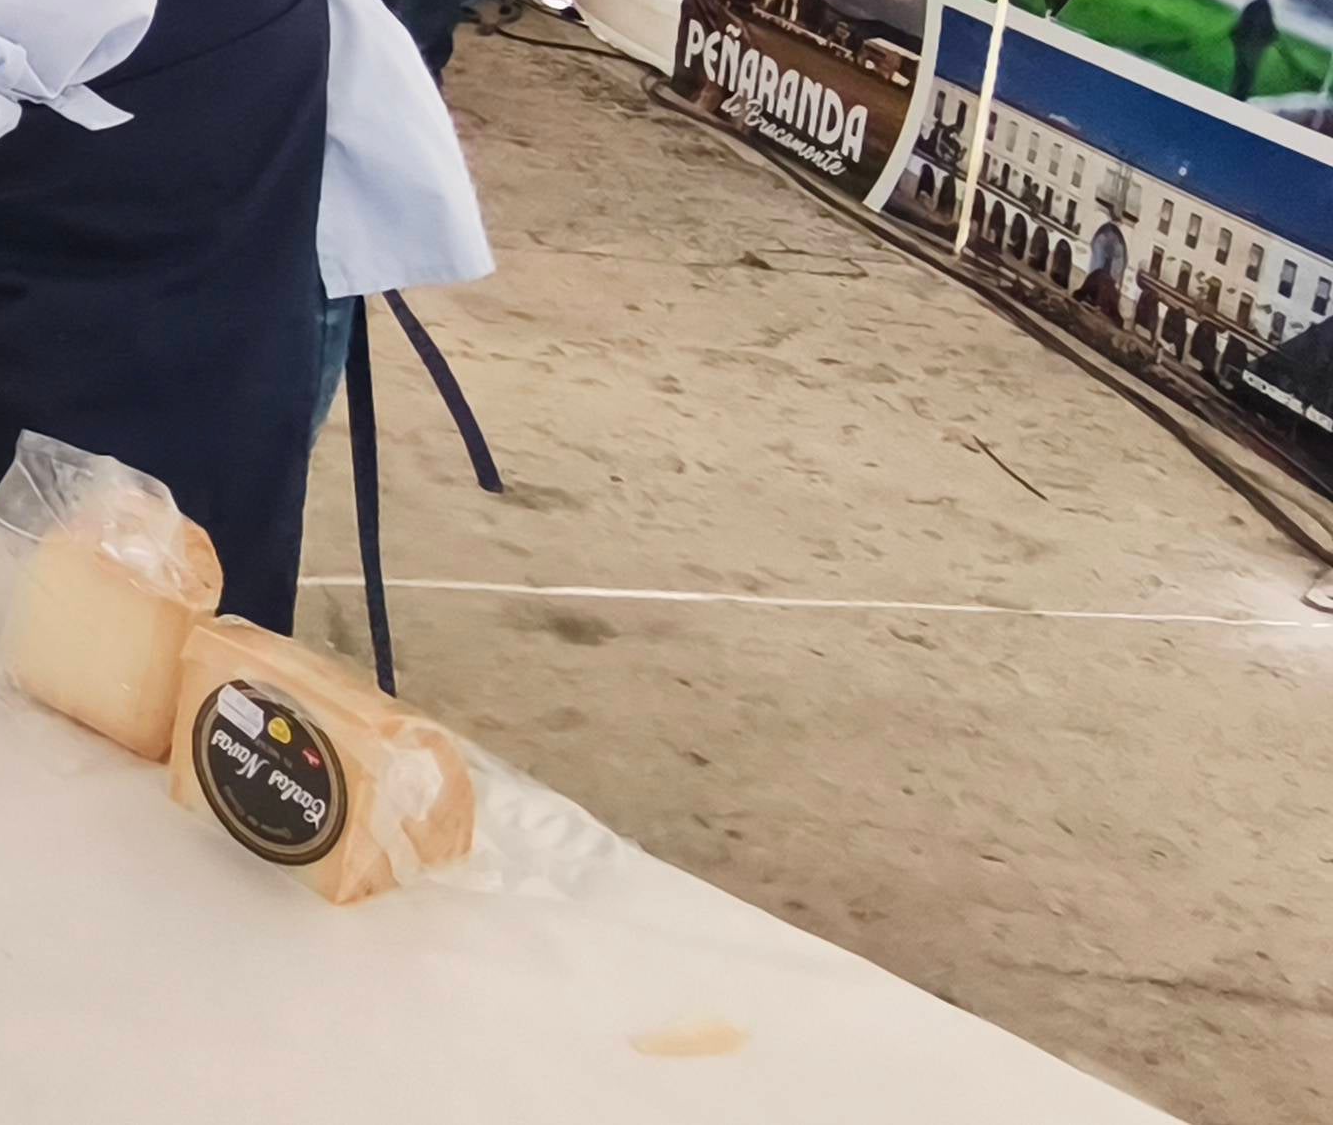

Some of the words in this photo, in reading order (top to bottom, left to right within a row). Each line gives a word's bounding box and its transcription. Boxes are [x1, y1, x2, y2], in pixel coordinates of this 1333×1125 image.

[684, 18, 869, 164] PEÑARANDA
[720, 91, 742, 118] de
[744, 98, 847, 176] Bracamonte
[210, 728, 272, 780] Navas
[267, 769, 327, 832] Carlos
